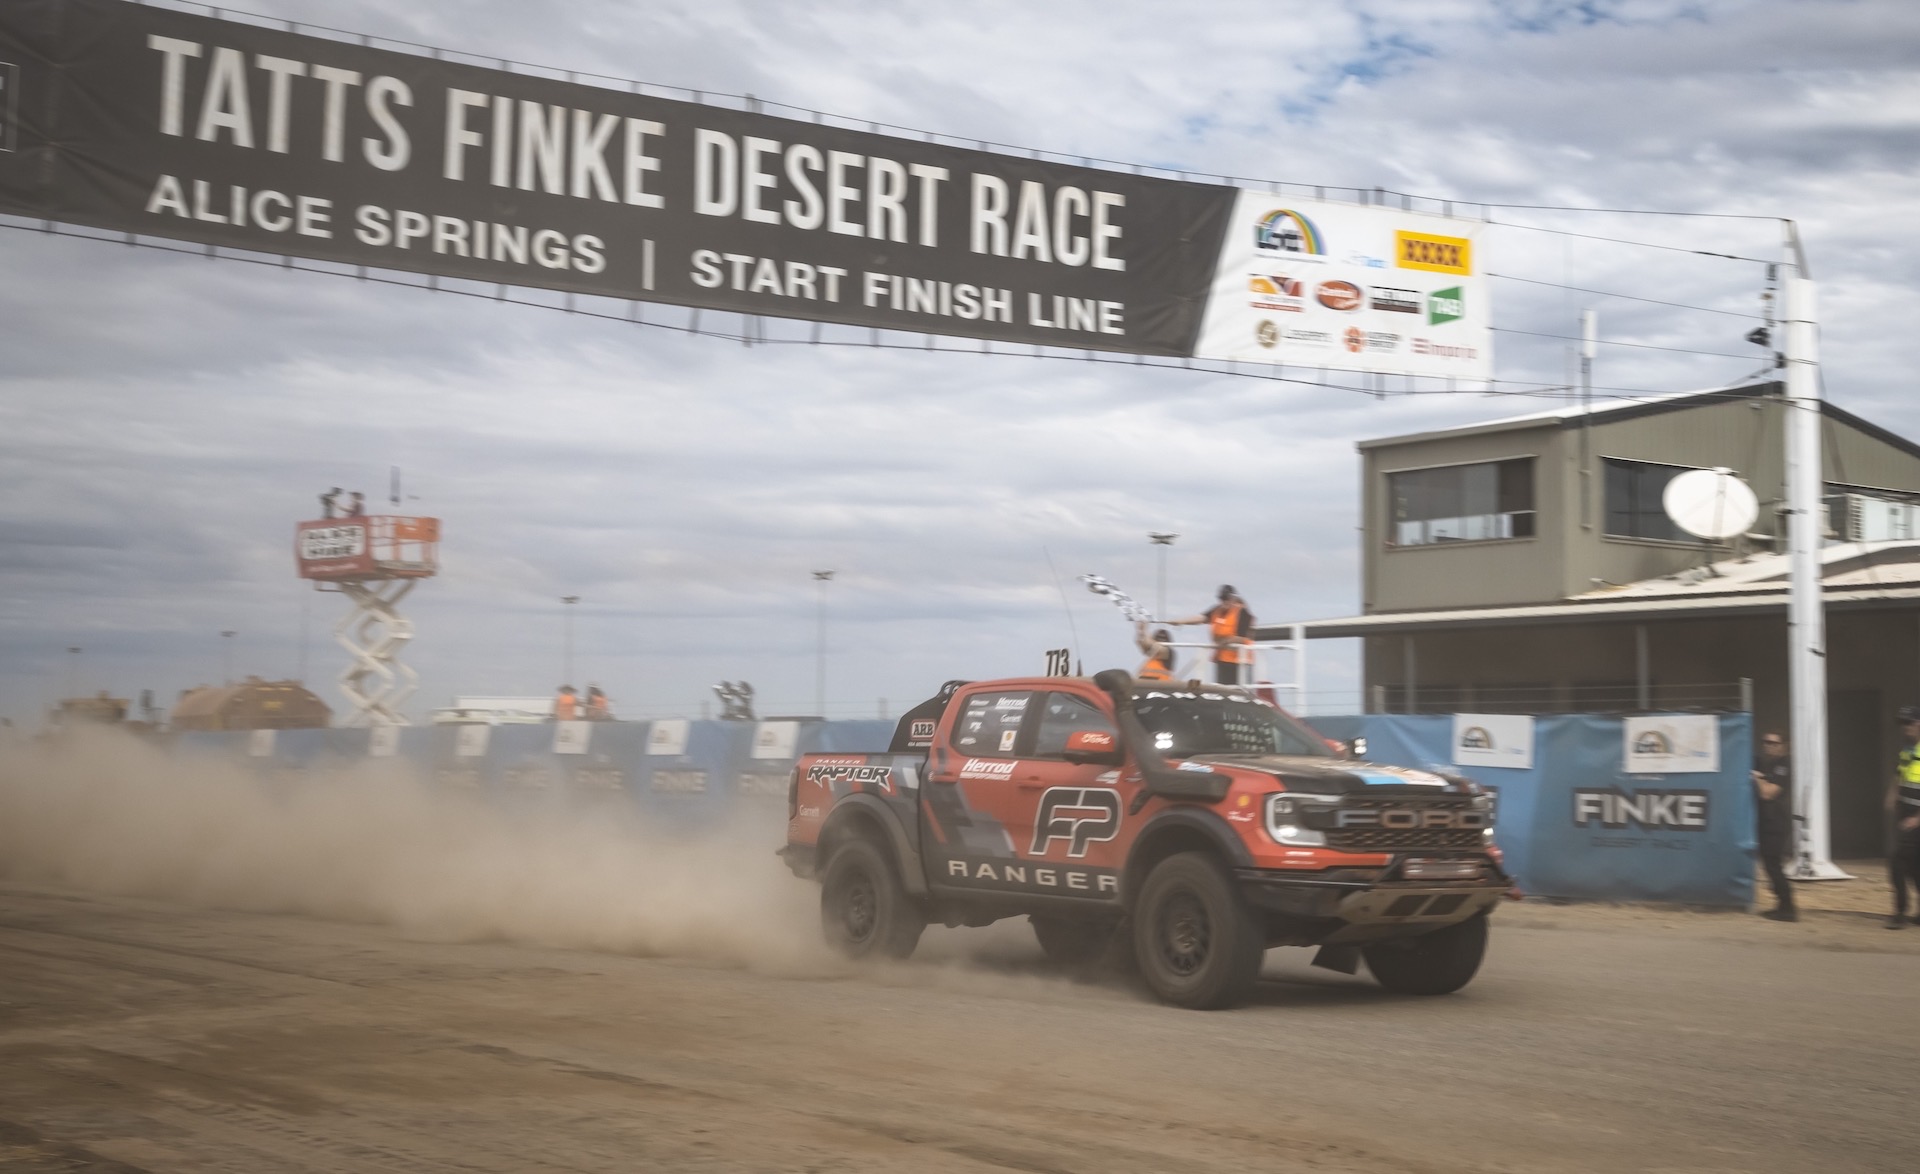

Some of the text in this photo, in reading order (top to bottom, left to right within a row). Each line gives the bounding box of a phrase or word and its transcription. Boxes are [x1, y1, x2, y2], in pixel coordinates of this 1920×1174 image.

[147, 34, 414, 172] TATTS
[444, 86, 666, 209] FINKE
[694, 127, 950, 248] DESERT
[970, 172, 1127, 272] RACE
[145, 174, 334, 239] ALICE
[354, 204, 607, 274] SPRINGS
[690, 249, 848, 303] START
[863, 271, 1014, 324] FINISH
[1028, 293, 1126, 336] LINE
[1402, 238, 1464, 268] XXXX
[1046, 648, 1070, 677] 773
[913, 723, 934, 736] ARB
[806, 764, 892, 793] RAPTOR
[961, 759, 1019, 774] Herrod
[1574, 792, 1708, 827] FINKE
[948, 860, 1119, 893] RANGER
